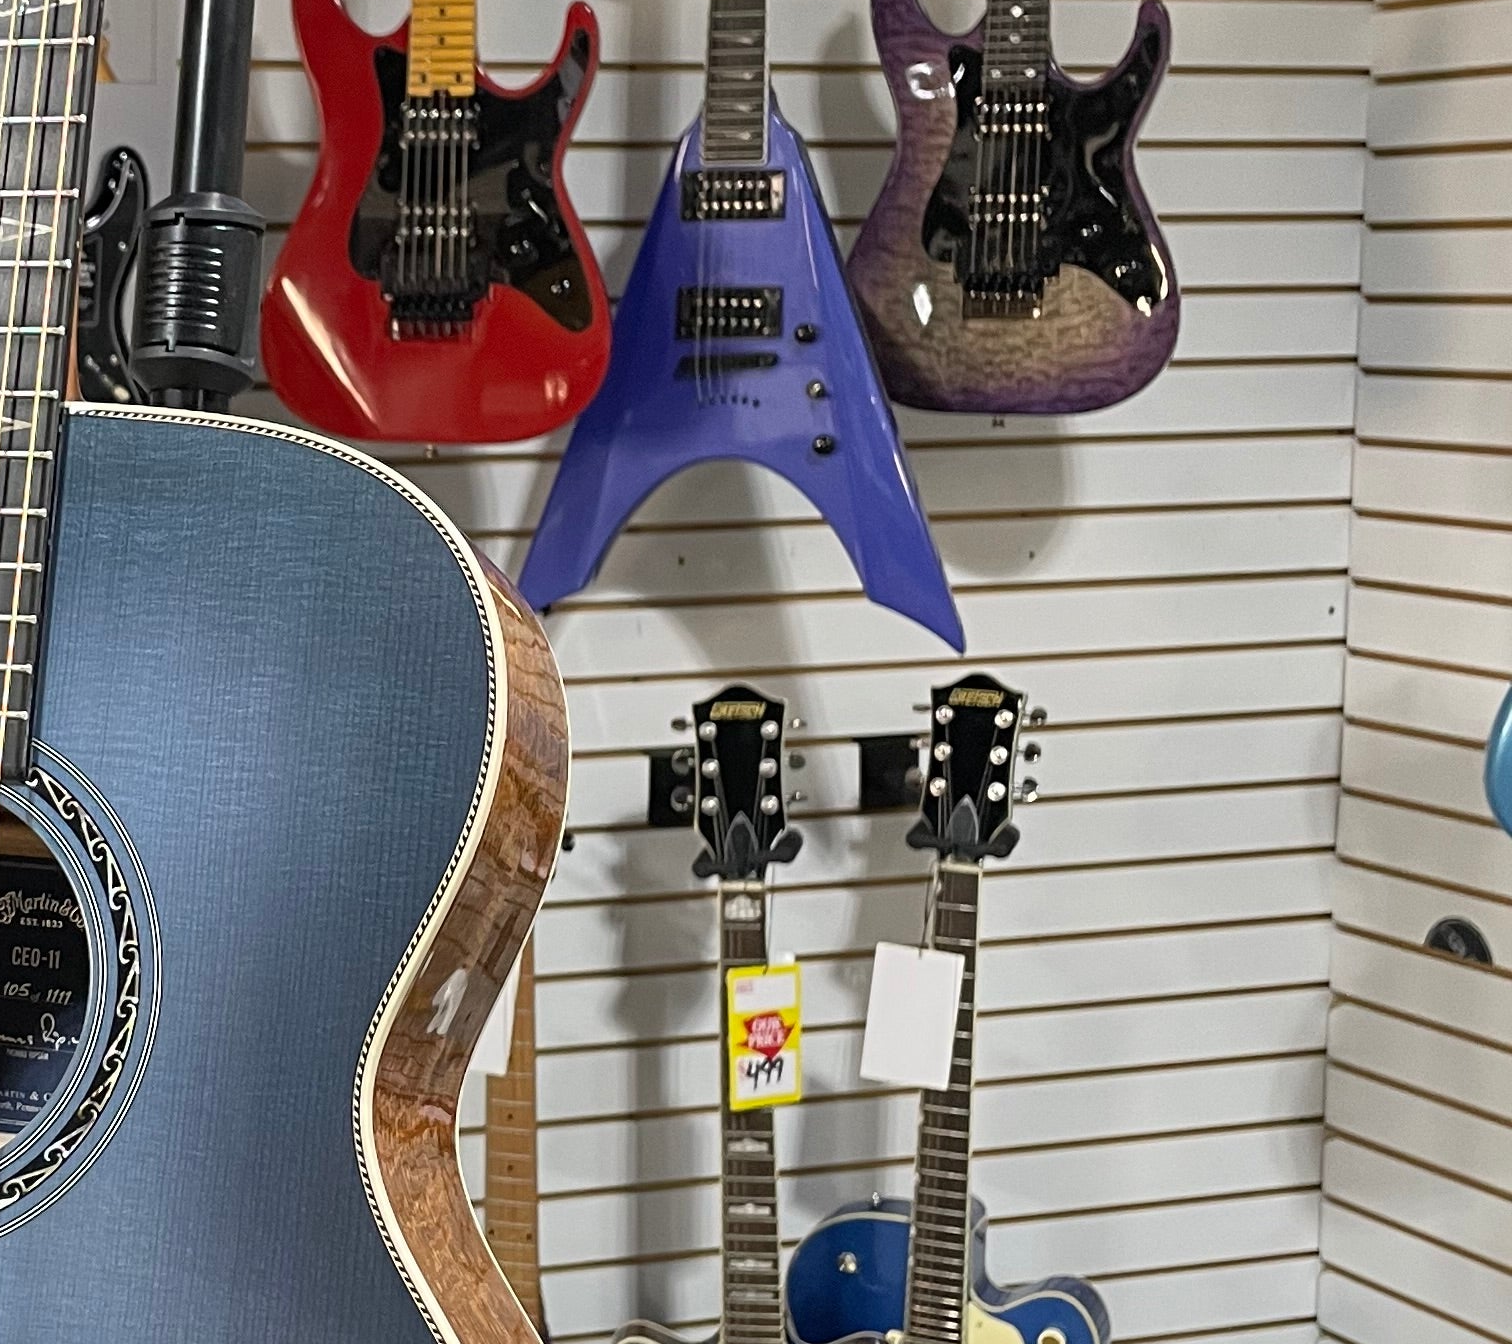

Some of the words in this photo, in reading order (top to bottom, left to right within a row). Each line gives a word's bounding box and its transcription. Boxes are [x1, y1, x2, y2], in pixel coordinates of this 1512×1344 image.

[11, 946, 61, 970] CEO-11
[3, 981, 32, 997] 105
[46, 988, 73, 1006] 1111
